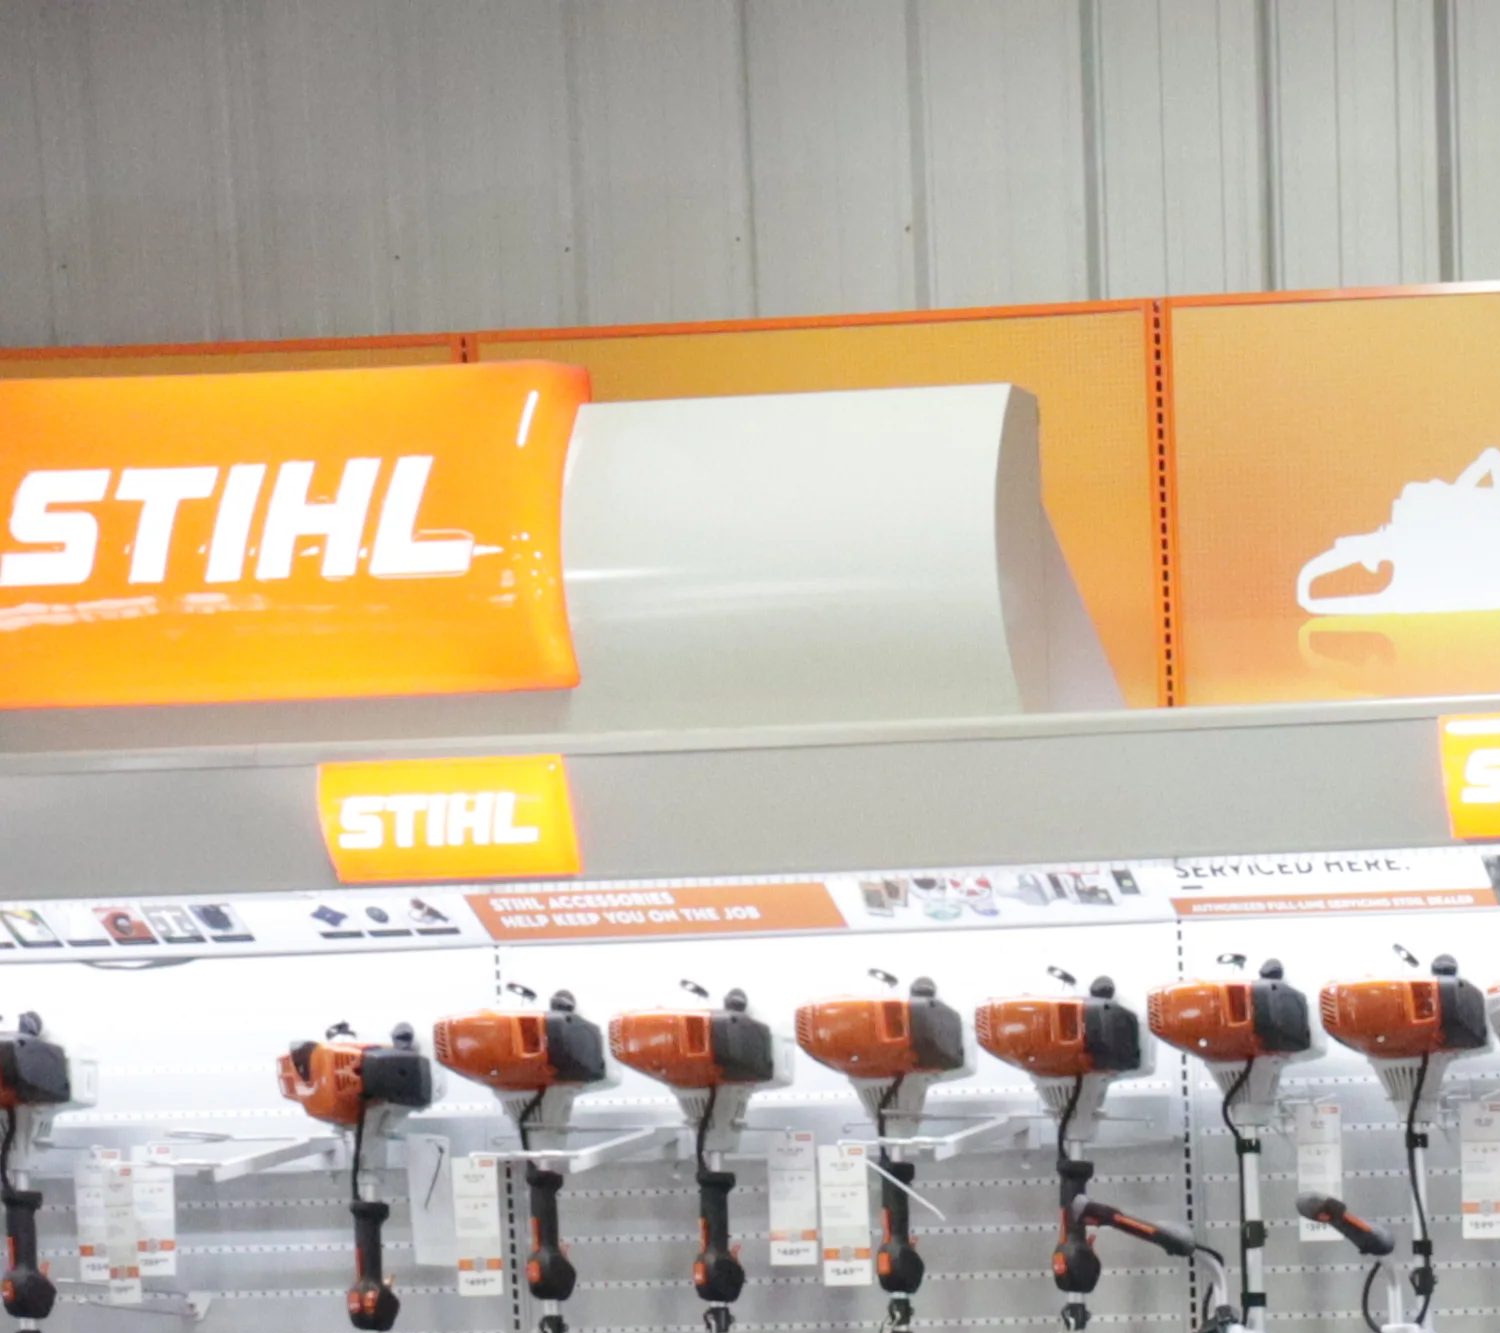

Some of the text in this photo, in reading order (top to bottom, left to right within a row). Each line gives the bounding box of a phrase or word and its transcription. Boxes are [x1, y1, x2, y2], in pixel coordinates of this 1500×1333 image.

[0, 455, 474, 588] STIHL
[337, 790, 541, 851] STIHL
[489, 891, 677, 912] STIHL ACCESSORIES
[500, 906, 762, 929] HELP KEEP YOU ON THE JOB
